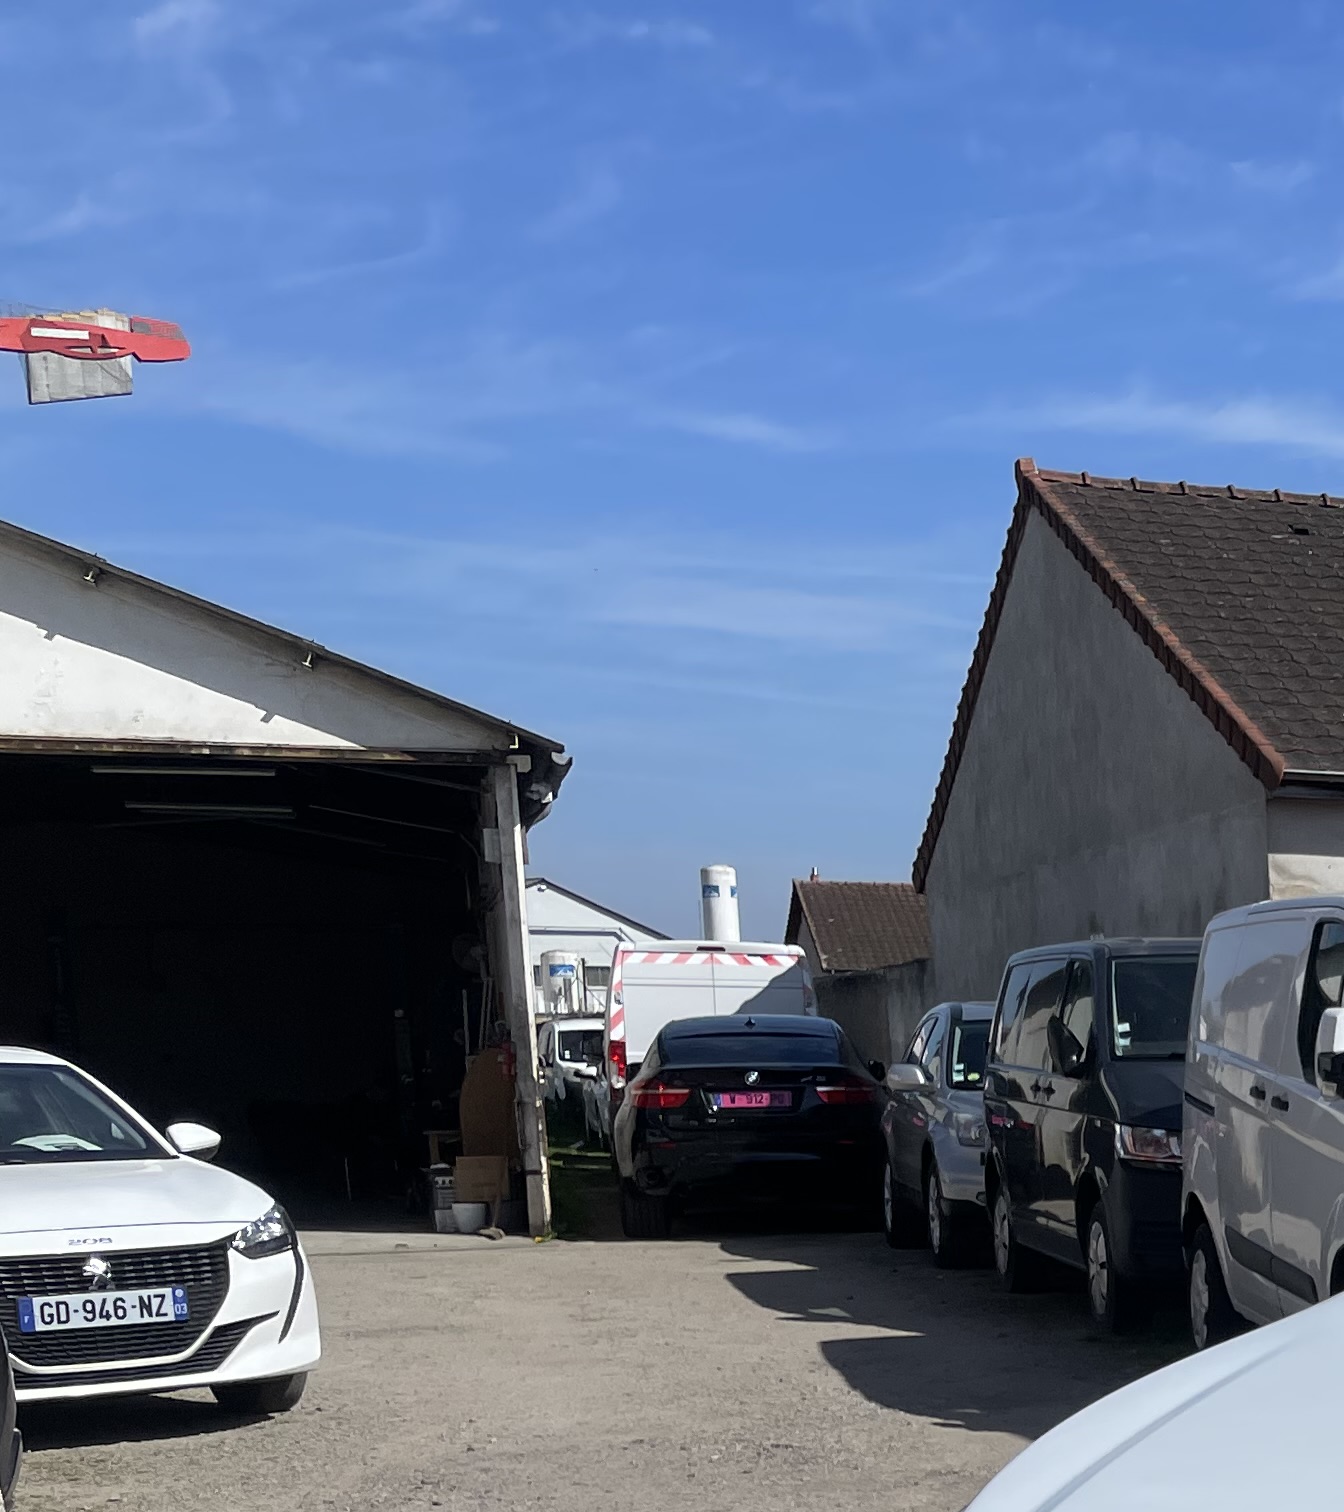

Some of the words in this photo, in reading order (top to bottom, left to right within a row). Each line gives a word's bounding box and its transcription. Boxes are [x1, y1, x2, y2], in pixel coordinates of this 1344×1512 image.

[68, 1237, 113, 1246] 208
[39, 1293, 169, 1326] GD-946-NZ
[174, 1302, 188, 1316] 03
